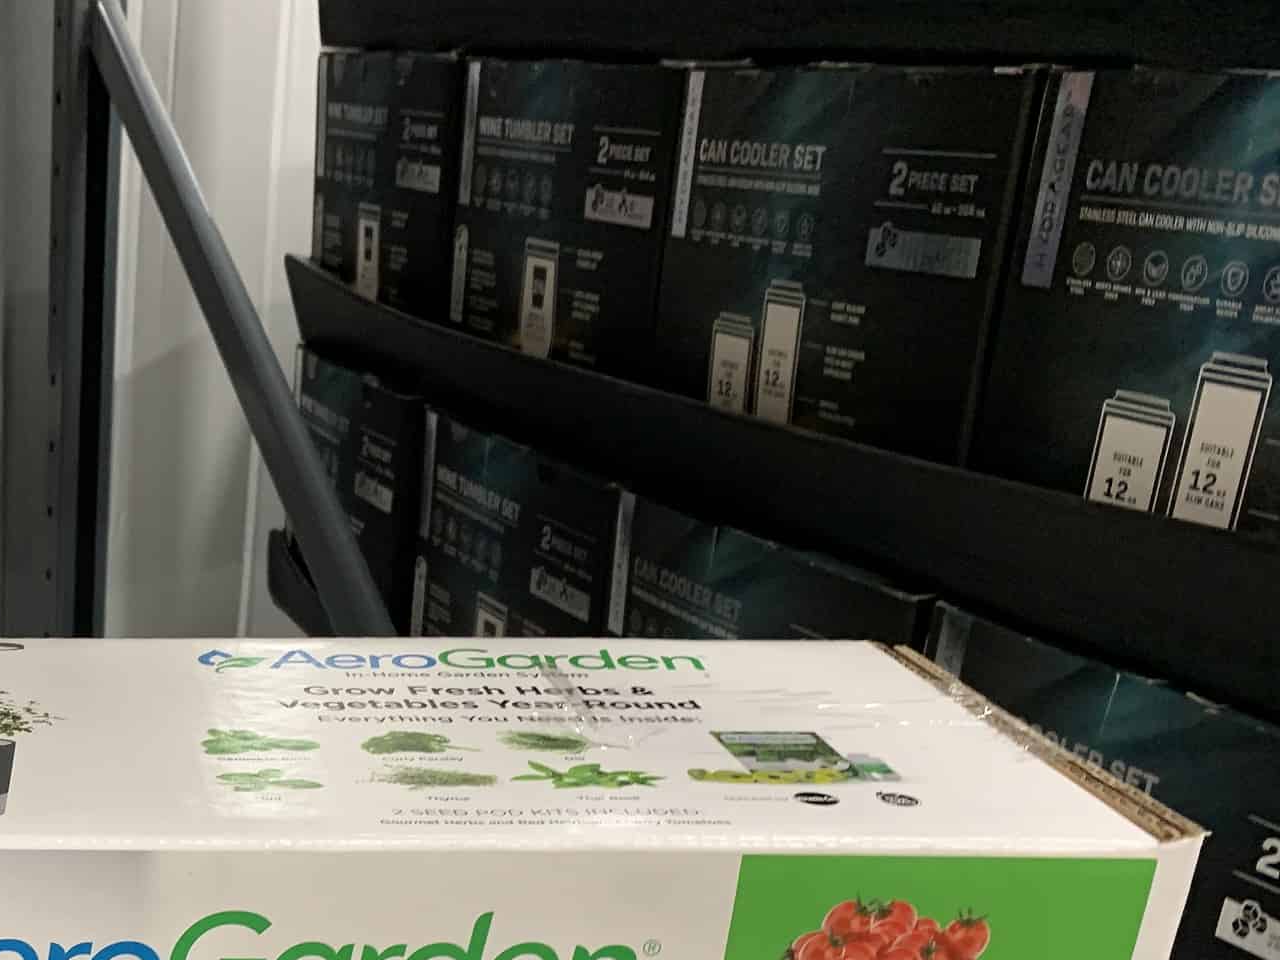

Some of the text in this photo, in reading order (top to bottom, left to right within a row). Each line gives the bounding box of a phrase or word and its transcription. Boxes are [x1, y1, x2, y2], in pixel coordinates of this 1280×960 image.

[598, 135, 610, 164] 2
[700, 138, 827, 171] CAN COOLER SET
[889, 160, 908, 196] 2
[949, 173, 980, 195] SET
[1086, 160, 1139, 194] CAN
[1143, 163, 1253, 204] COOLER
[1103, 477, 1128, 500] 12
[1189, 470, 1217, 494] 12
[270, 648, 705, 670] AeroGarden
[345, 671, 431, 679] In-Home
[303, 685, 655, 697] Grow Fresh Herbs &
[279, 699, 702, 711] Vegetables Year-Round
[318, 714, 454, 724] Everything
[1256, 836, 1280, 881] 2
